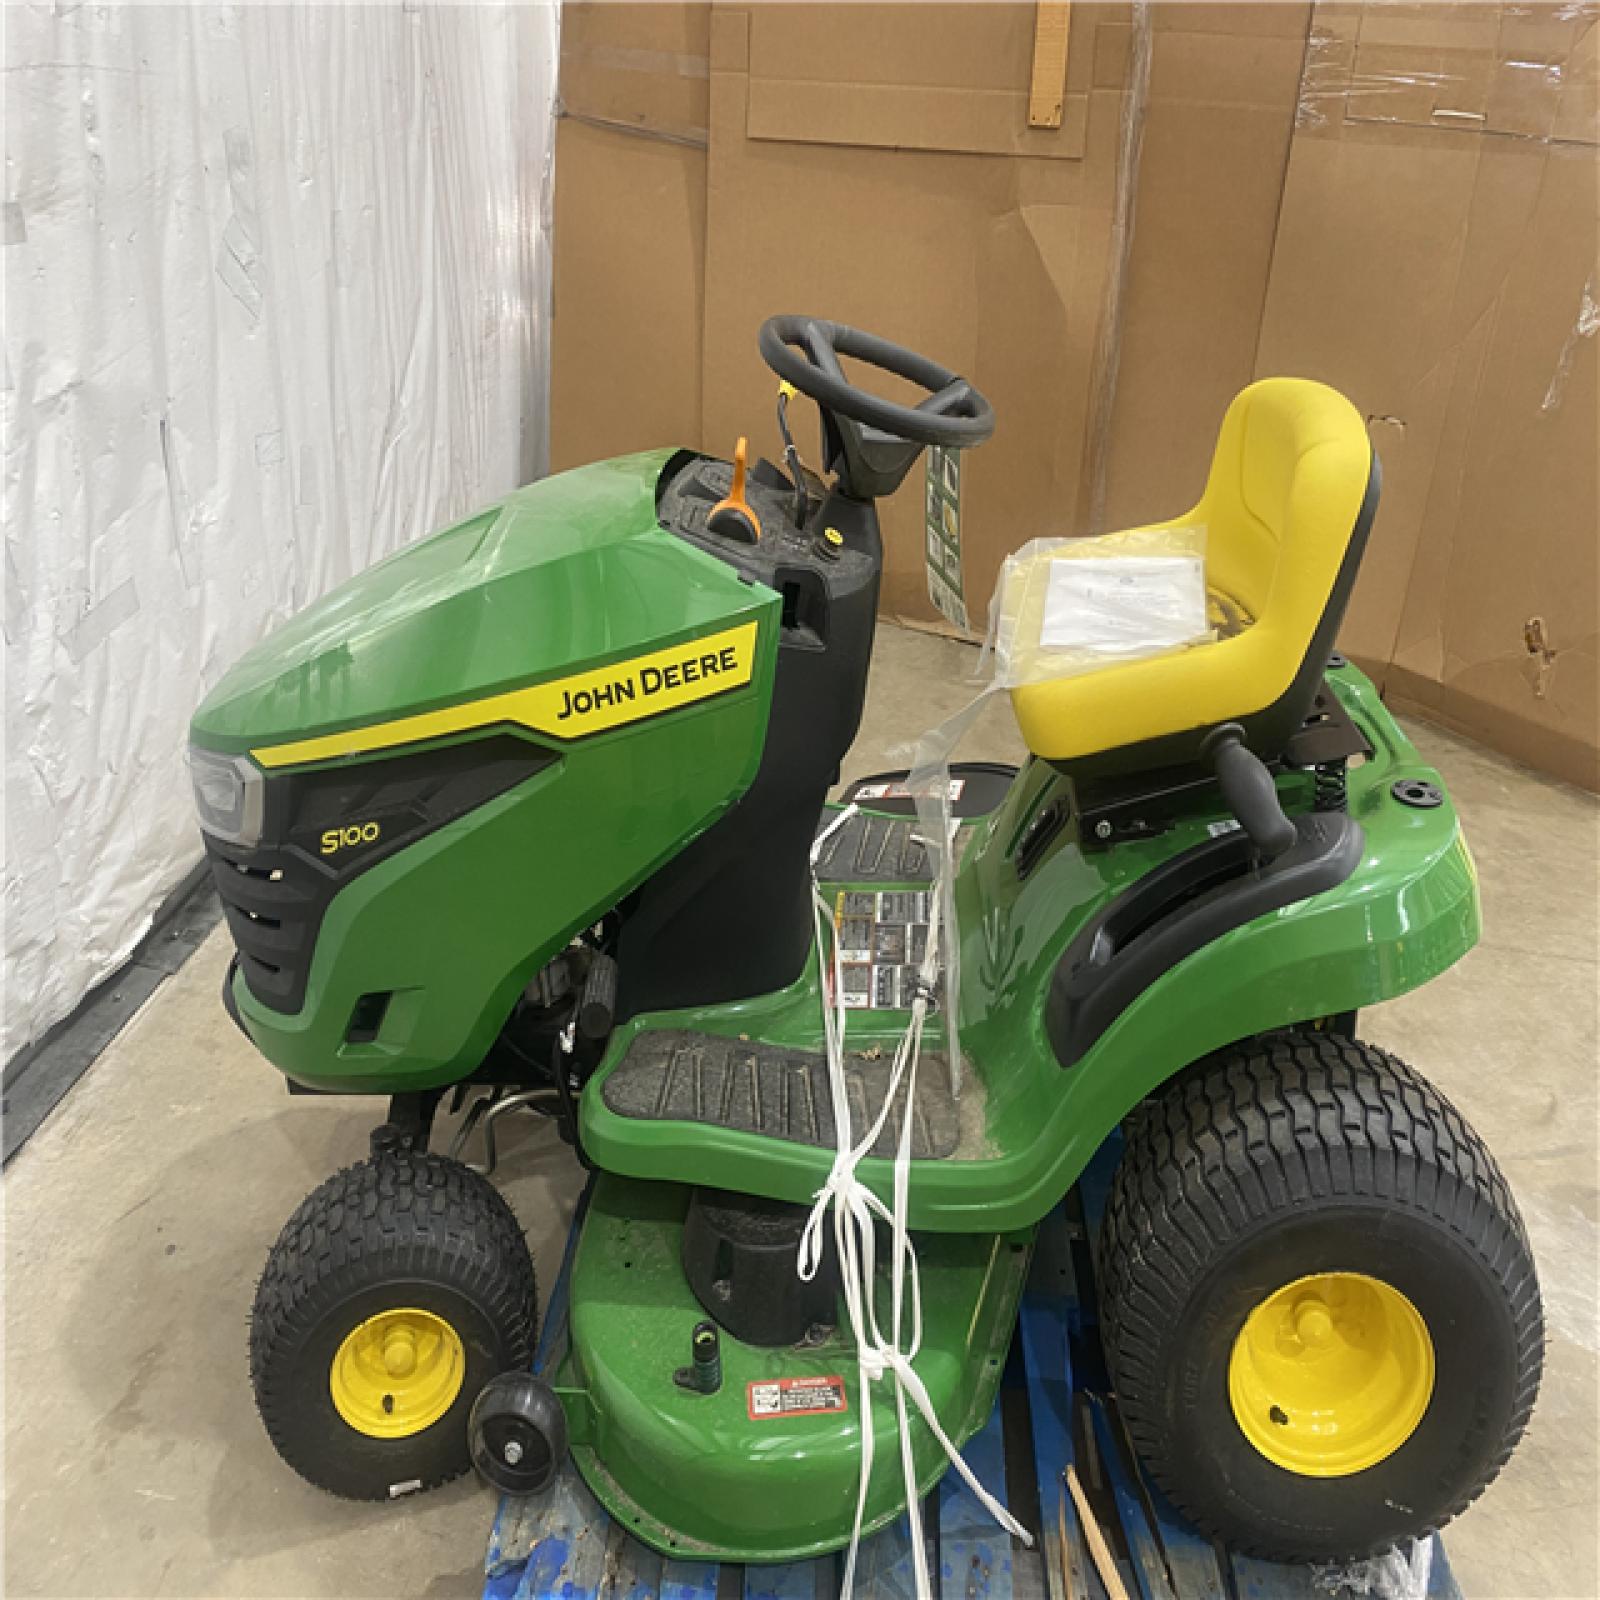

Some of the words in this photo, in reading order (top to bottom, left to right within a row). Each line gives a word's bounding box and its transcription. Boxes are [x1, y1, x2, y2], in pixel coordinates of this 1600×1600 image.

[557, 679, 635, 720] JOHN
[640, 647, 738, 695] DEERE
[321, 822, 379, 854] S100
